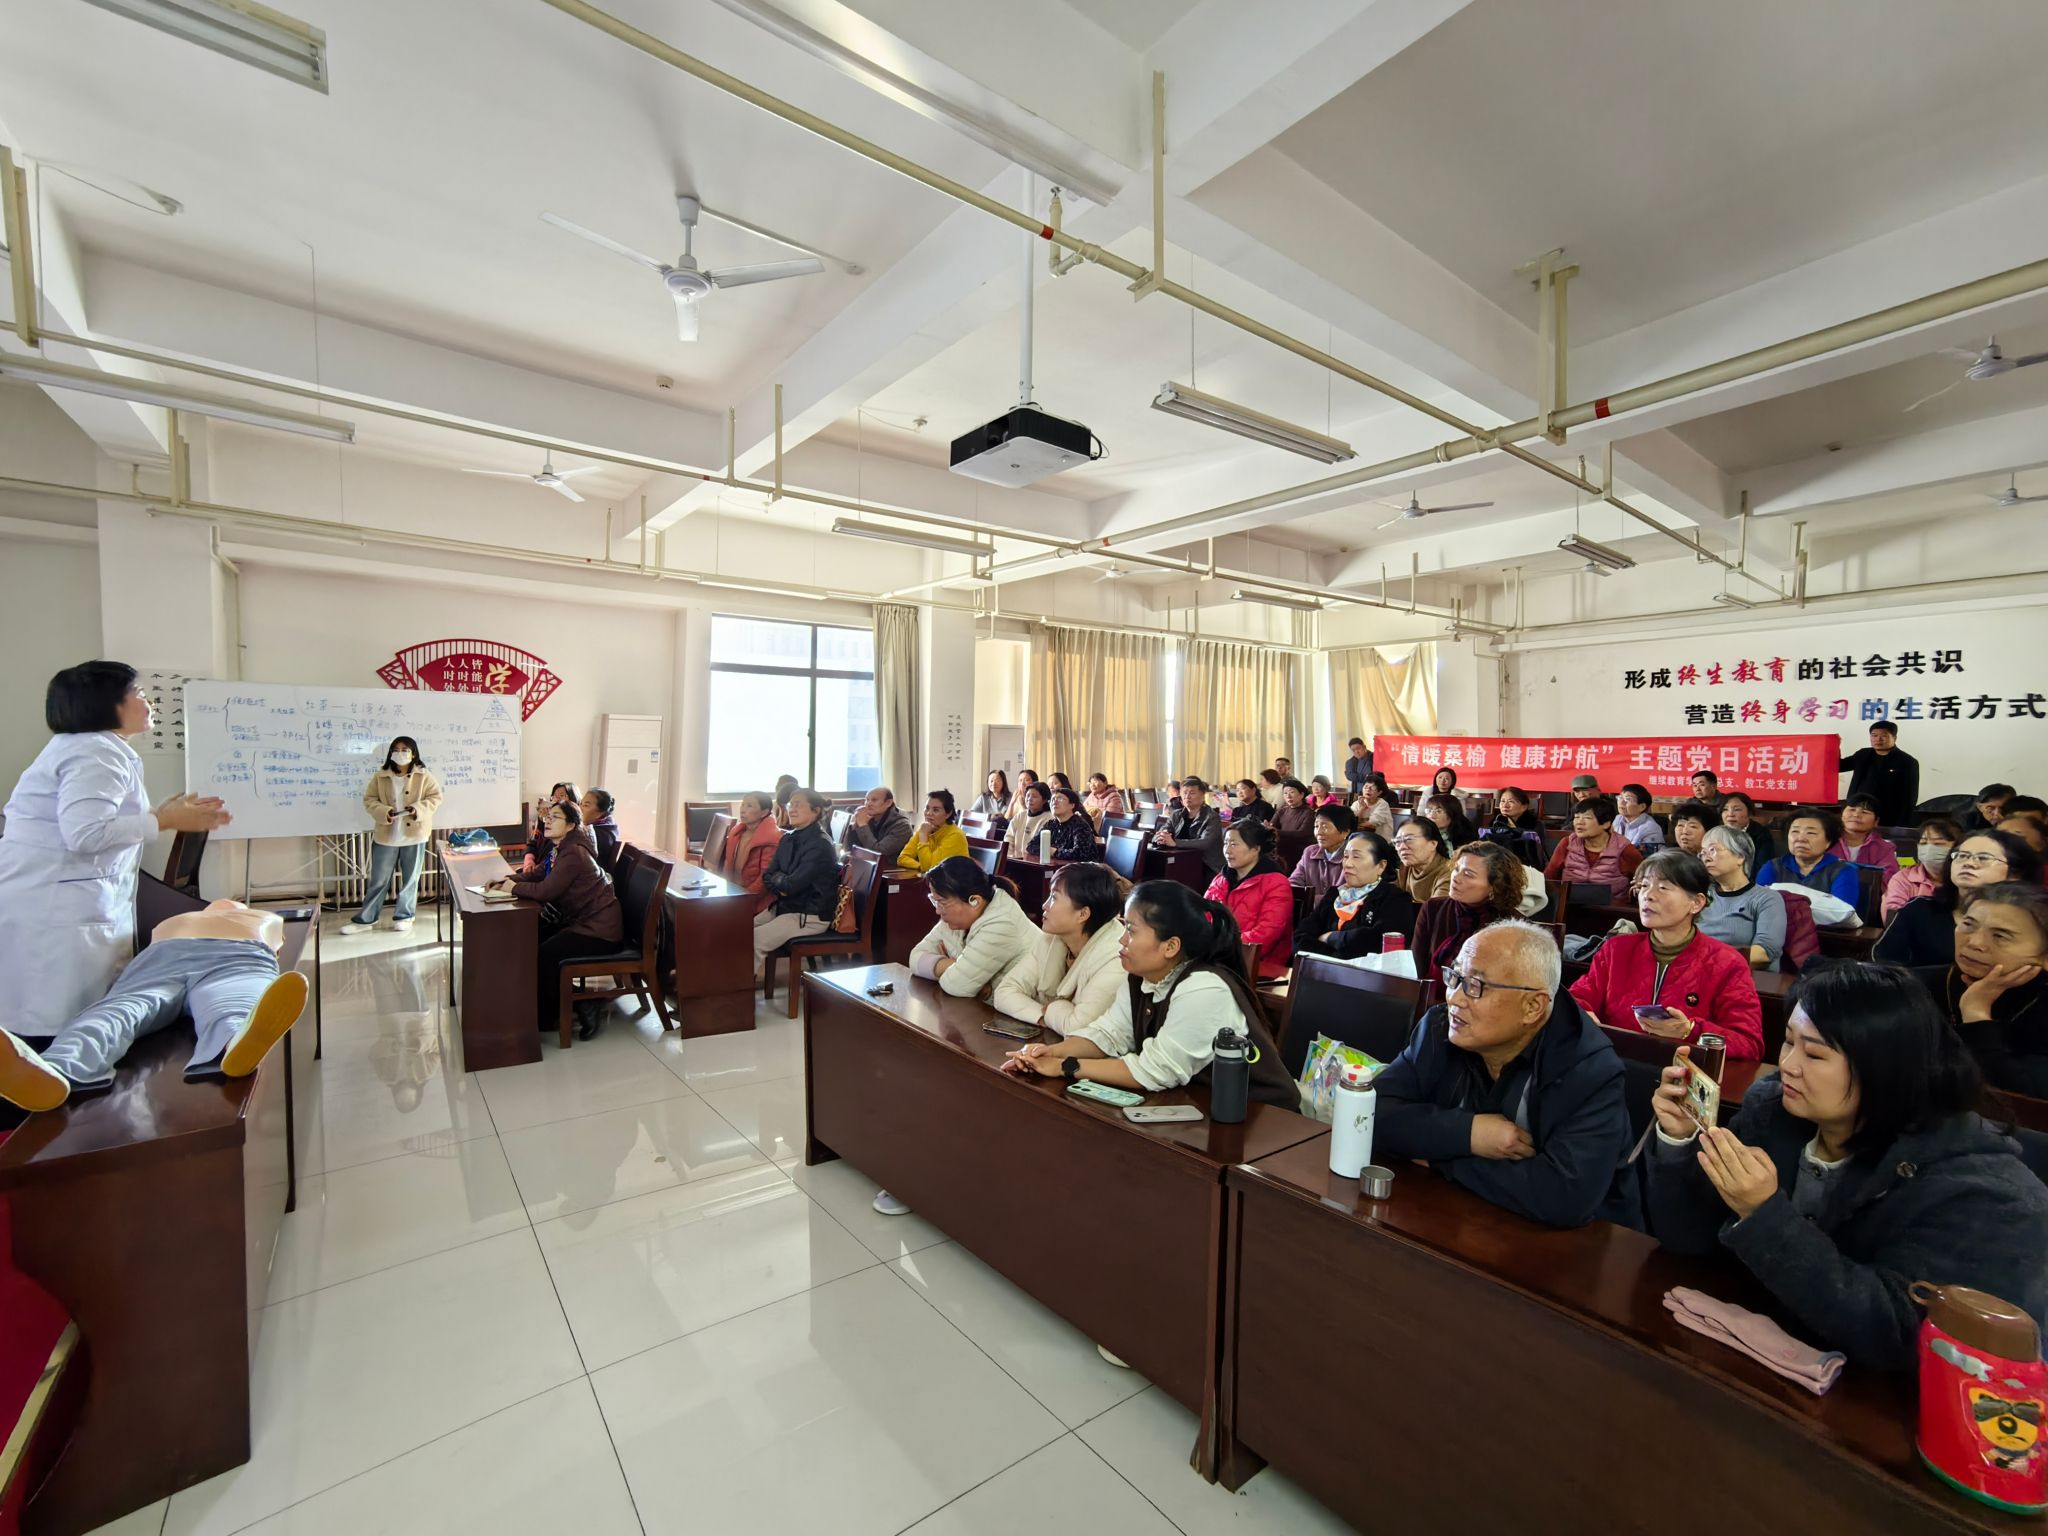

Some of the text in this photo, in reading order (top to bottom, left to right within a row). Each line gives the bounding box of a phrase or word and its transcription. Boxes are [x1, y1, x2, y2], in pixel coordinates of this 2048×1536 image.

[1624, 649, 1965, 690] 形成终生教育的社会共识
[1685, 693, 2047, 725] 营造终身学习的生活方式
[1629, 745, 1809, 775] 主题党日活动
